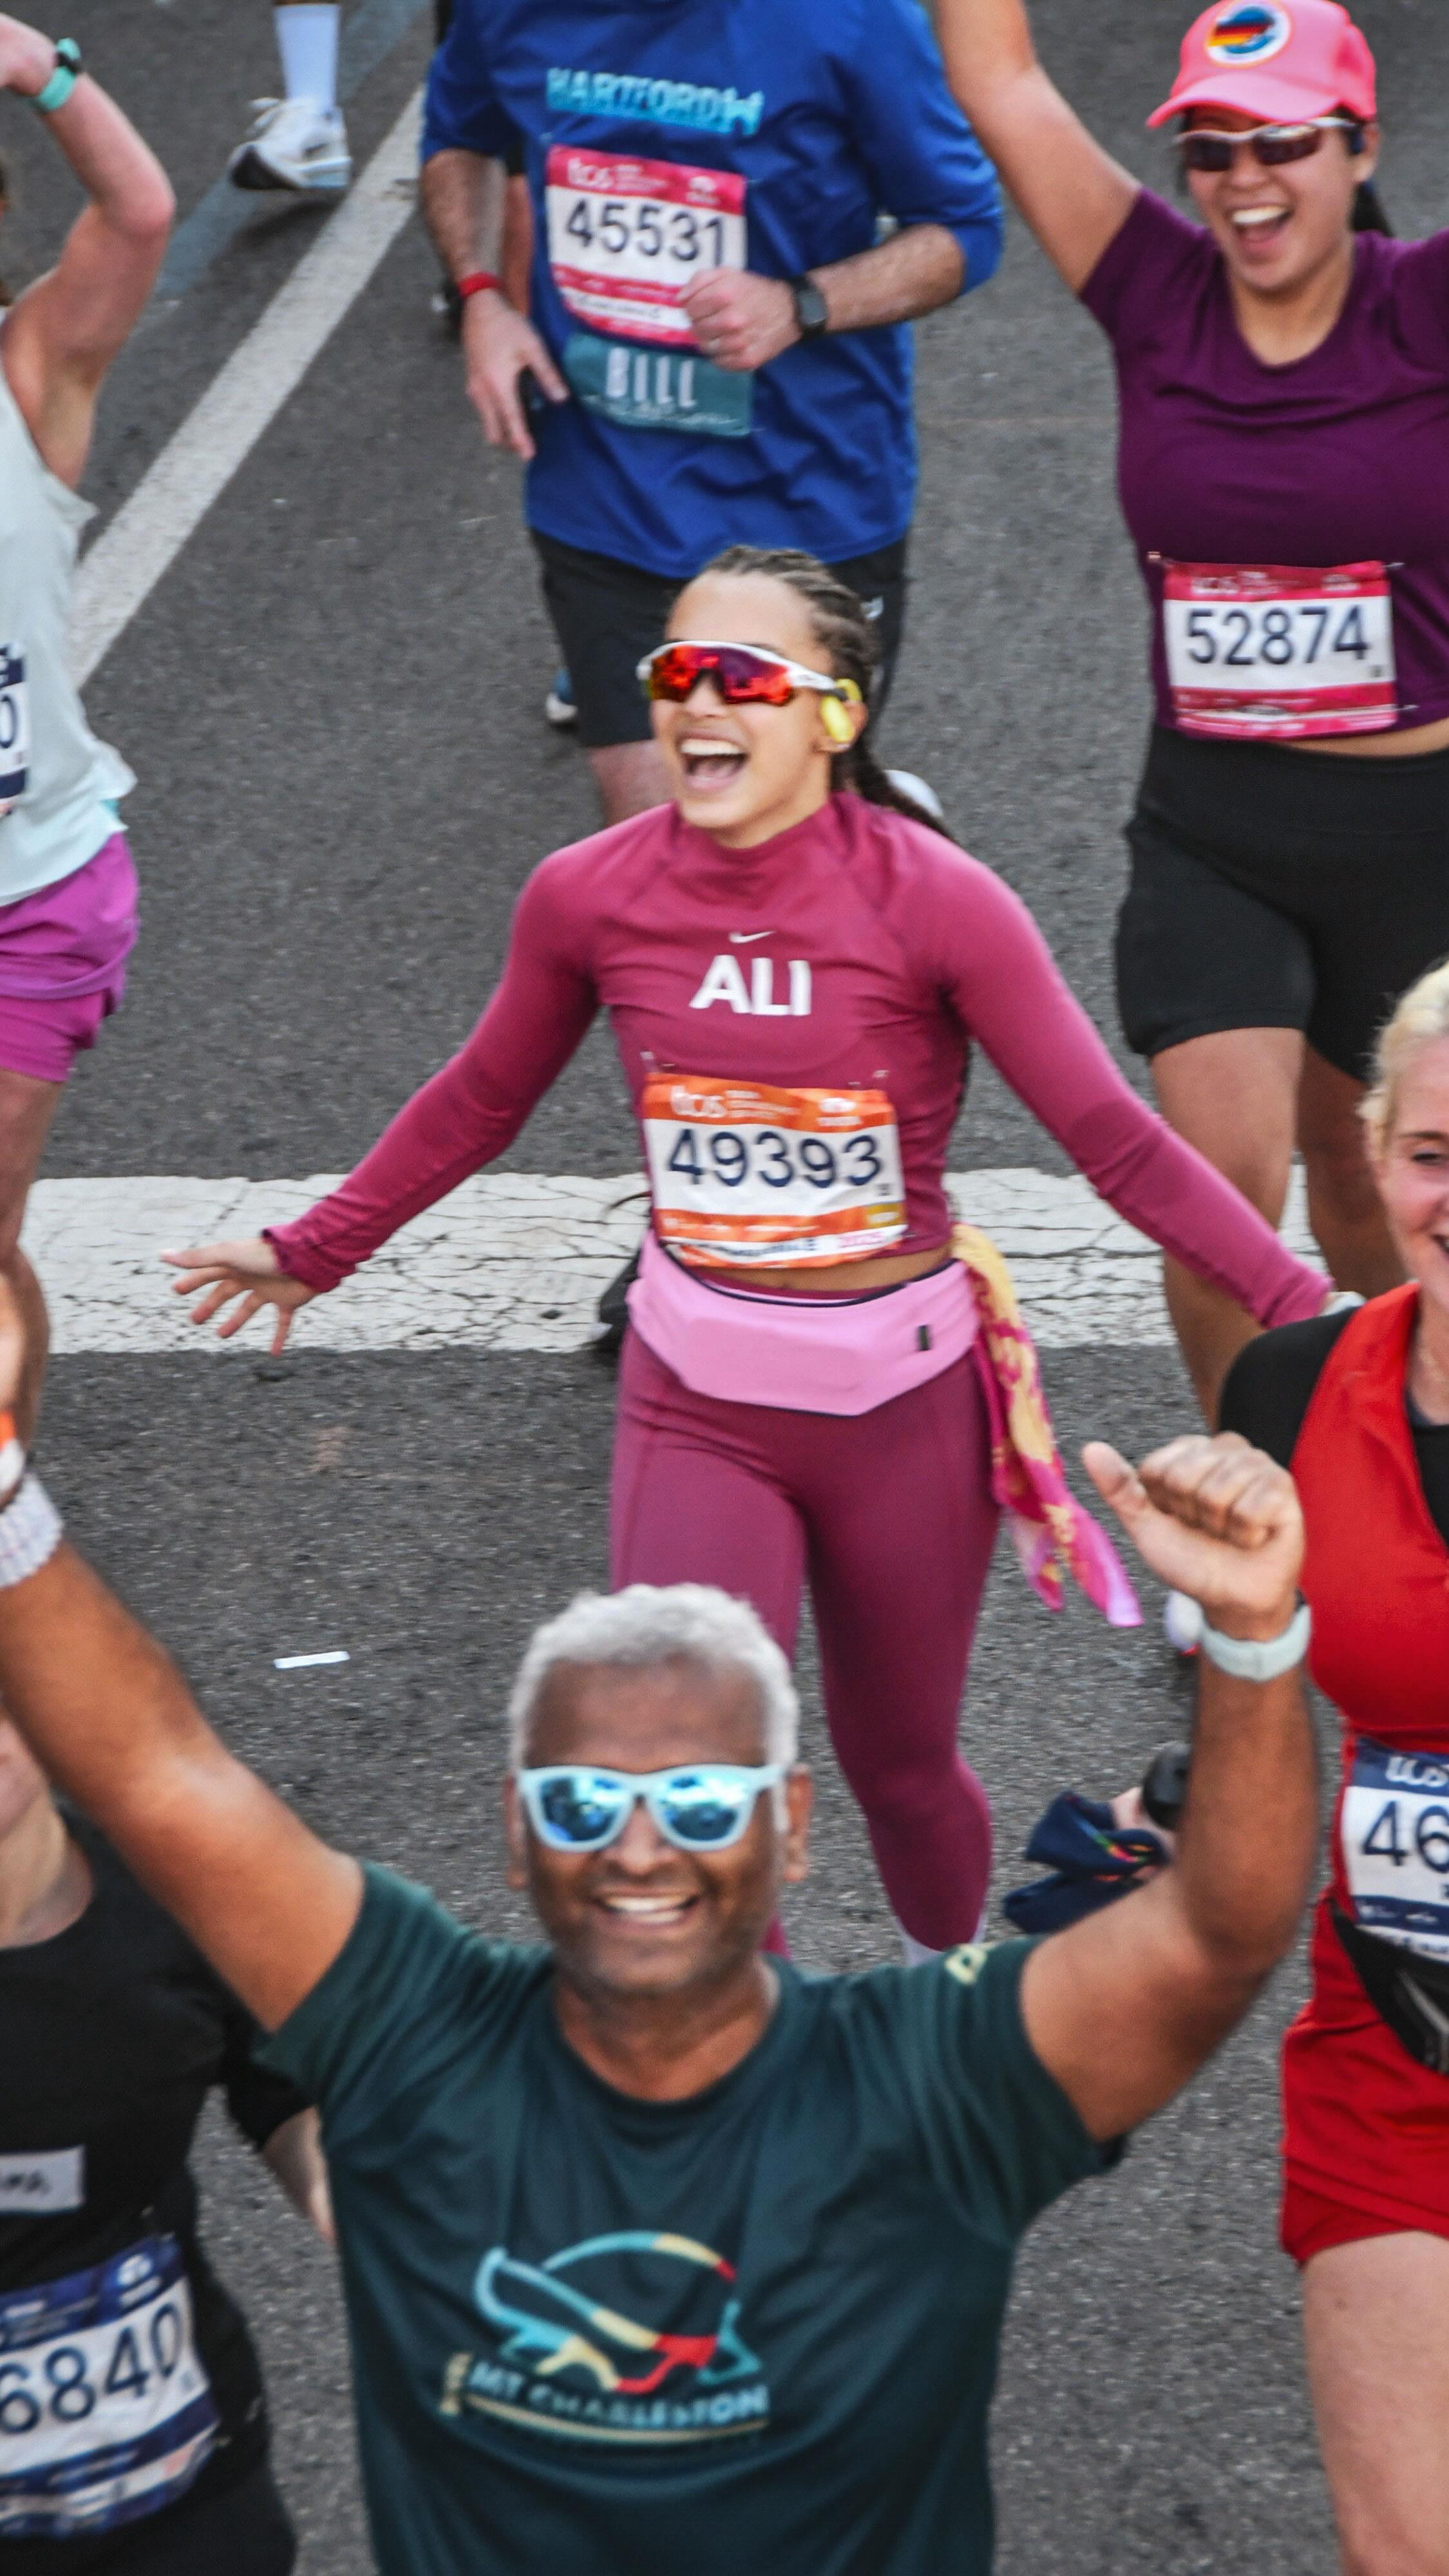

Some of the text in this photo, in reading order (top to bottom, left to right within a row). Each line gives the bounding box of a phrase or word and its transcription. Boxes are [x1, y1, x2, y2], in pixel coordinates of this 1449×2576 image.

[566, 198, 725, 267] 45531
[605, 346, 697, 408] BILL
[1186, 604, 1370, 665] 52874
[688, 954, 812, 1016] ALI
[667, 1128, 882, 1189] 49393
[1361, 1801, 1449, 1875] 46
[0, 2301, 186, 2434] 6840
